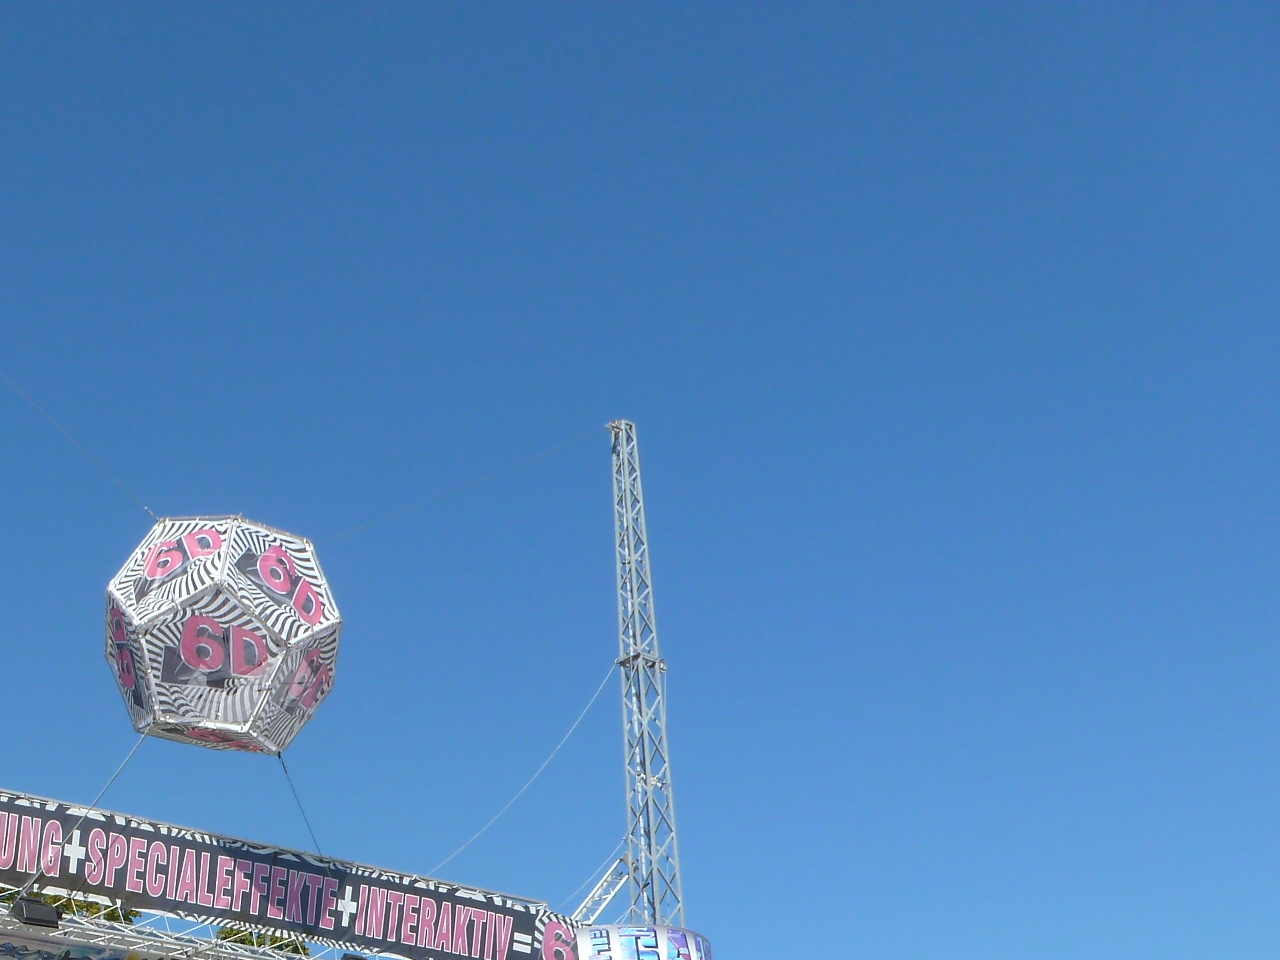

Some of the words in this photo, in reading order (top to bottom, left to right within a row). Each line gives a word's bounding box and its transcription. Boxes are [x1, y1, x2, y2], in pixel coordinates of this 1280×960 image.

[144, 528, 222, 580] 6D
[257, 546, 324, 625] 6D
[180, 615, 269, 677] 6D
[86, 827, 338, 930] SPECIALEFFEKTE
